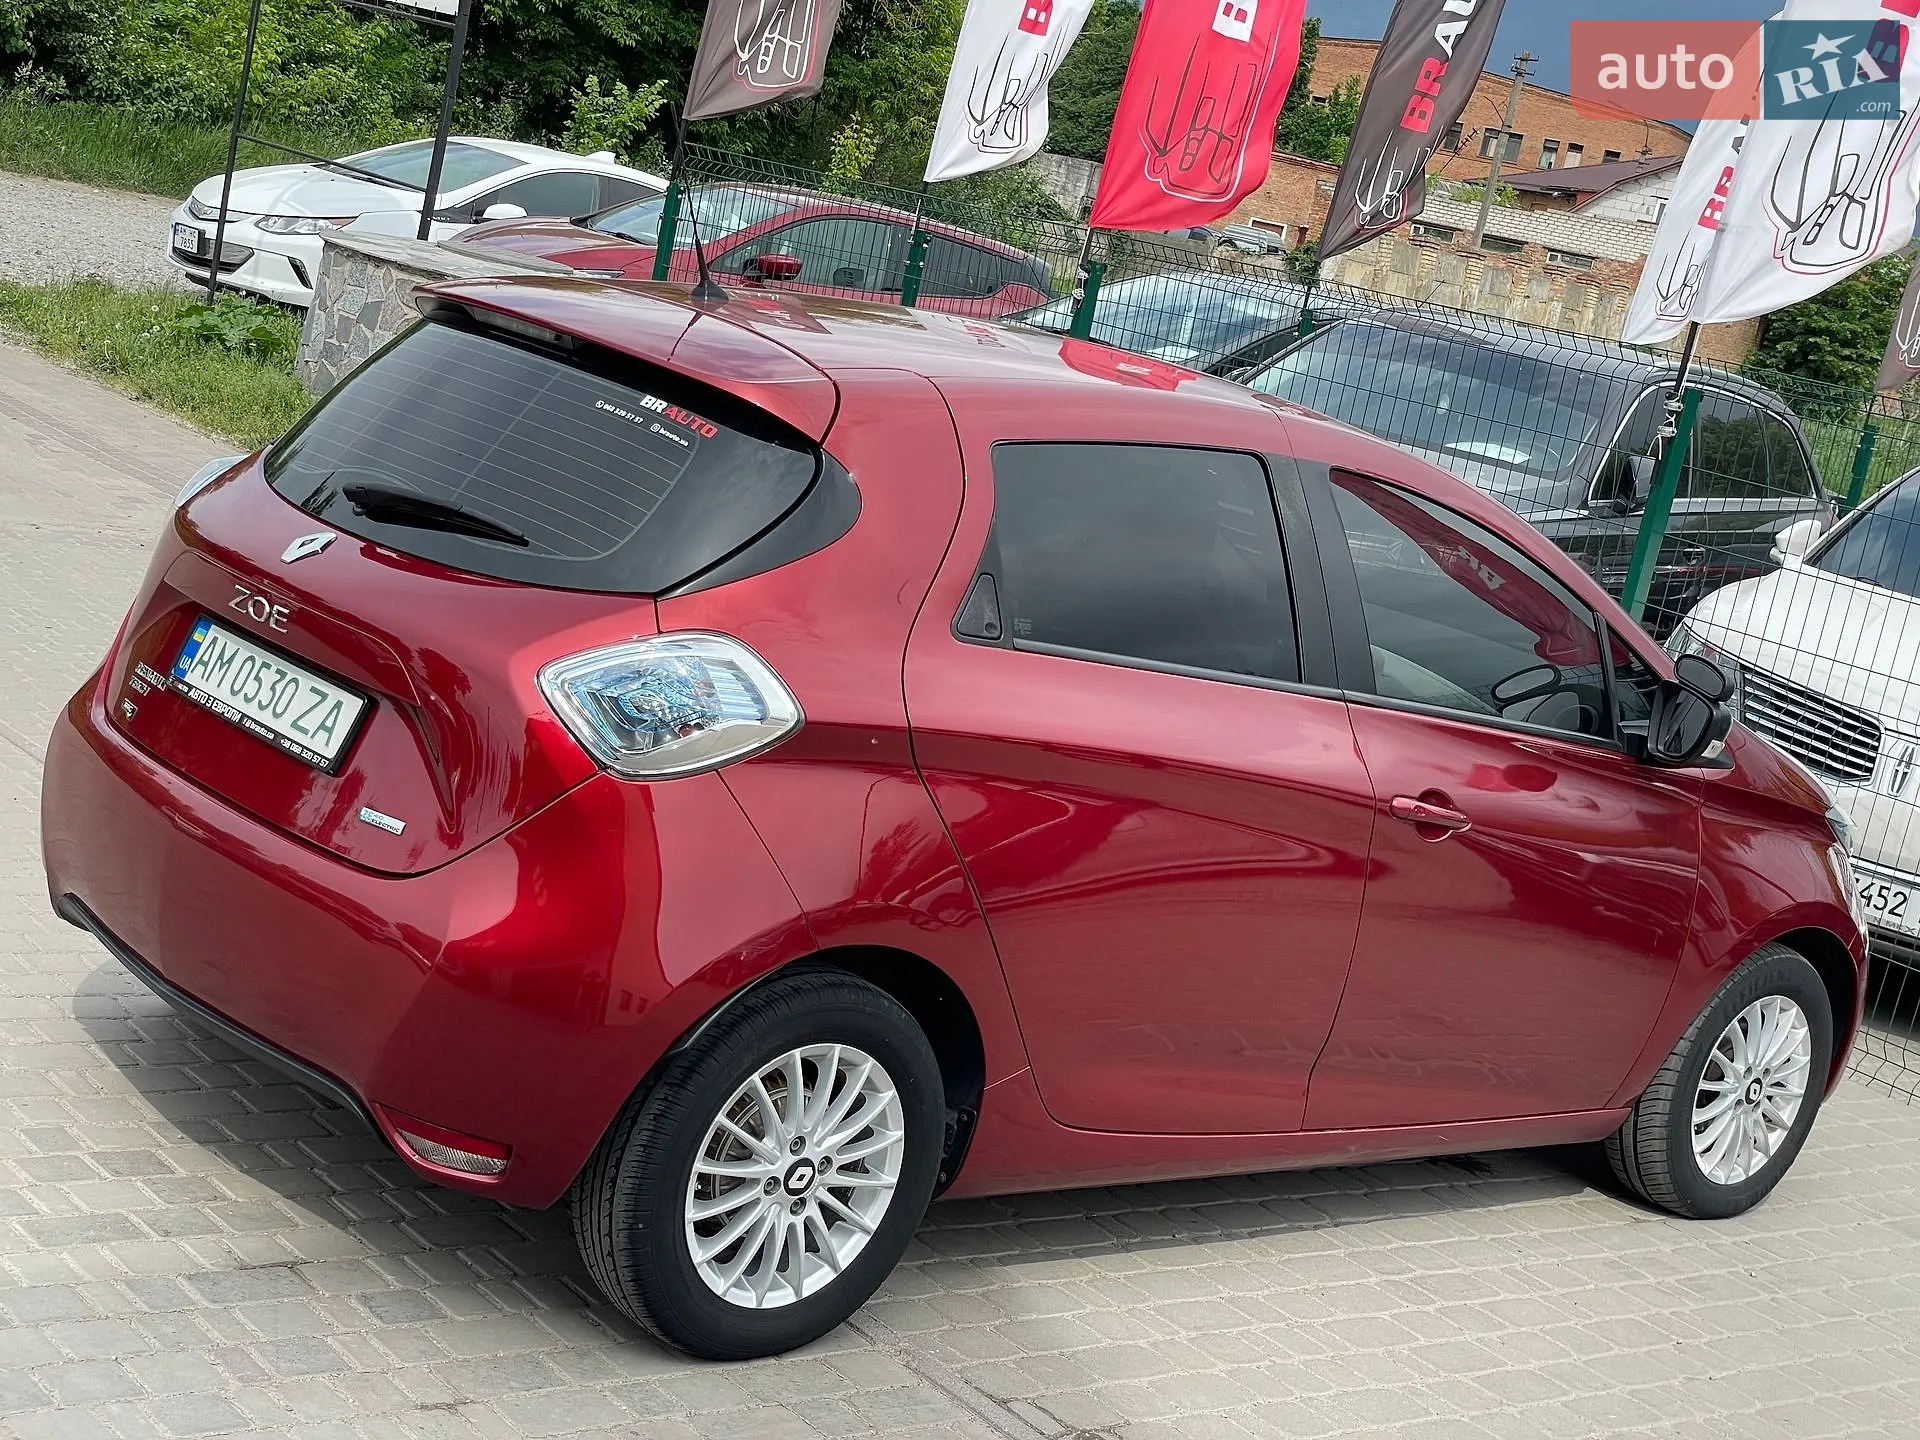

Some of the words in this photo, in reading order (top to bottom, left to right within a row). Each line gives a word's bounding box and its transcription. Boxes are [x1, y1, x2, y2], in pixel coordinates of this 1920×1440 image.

[625, 411, 636, 422] 57
[634, 415, 644, 424] 57
[640, 394, 718, 439] BRAUTO
[229, 584, 290, 633] ZOE
[179, 654, 193, 672] UA
[190, 635, 241, 689] AM
[229, 654, 300, 720] 0530
[289, 685, 344, 747] ZA
[1855, 877, 1908, 917] 452
